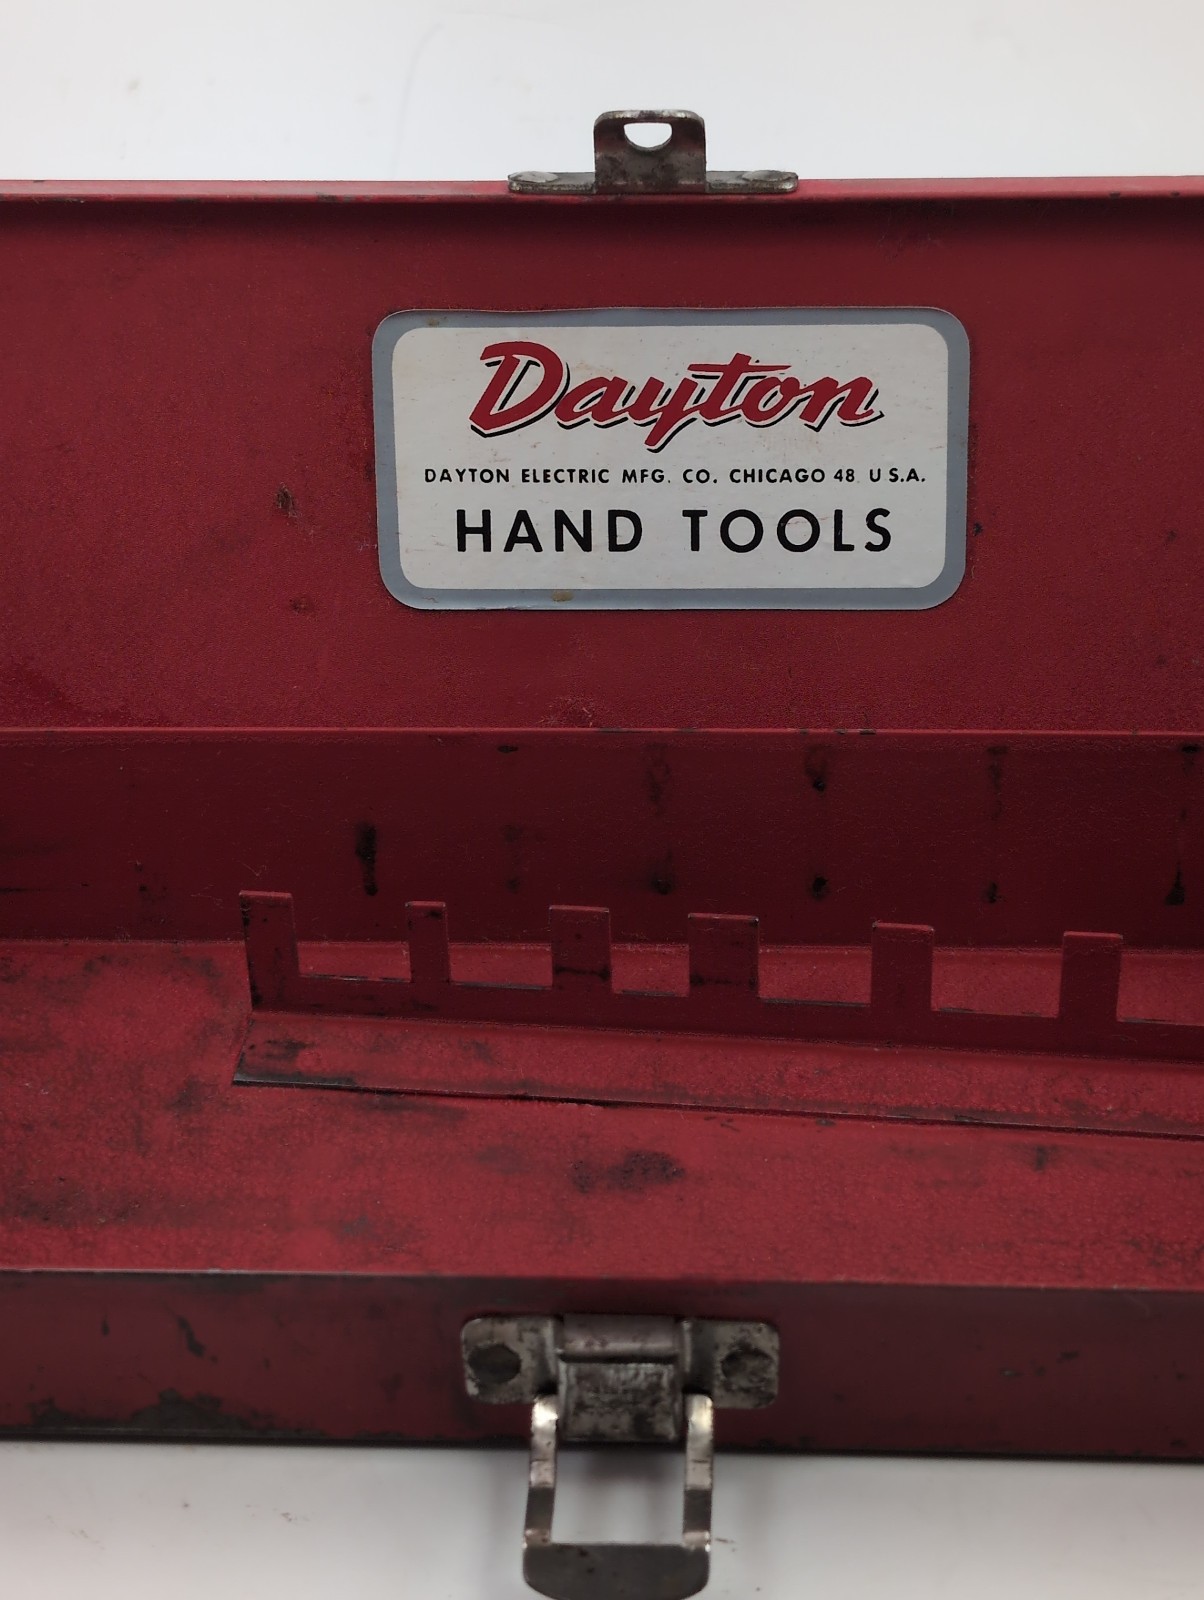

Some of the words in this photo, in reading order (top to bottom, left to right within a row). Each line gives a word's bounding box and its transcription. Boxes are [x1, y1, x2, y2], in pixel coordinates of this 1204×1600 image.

[469, 340, 885, 454] Dayton
[425, 468, 510, 484] DAYTON
[522, 468, 610, 484] ELECTRIC
[622, 468, 672, 484] MFG.
[682, 468, 719, 484] CO.
[729, 467, 826, 484] CHICAGO
[869, 467, 926, 483] US.A.
[457, 508, 643, 553] HAND
[682, 507, 892, 554] TOOLS
